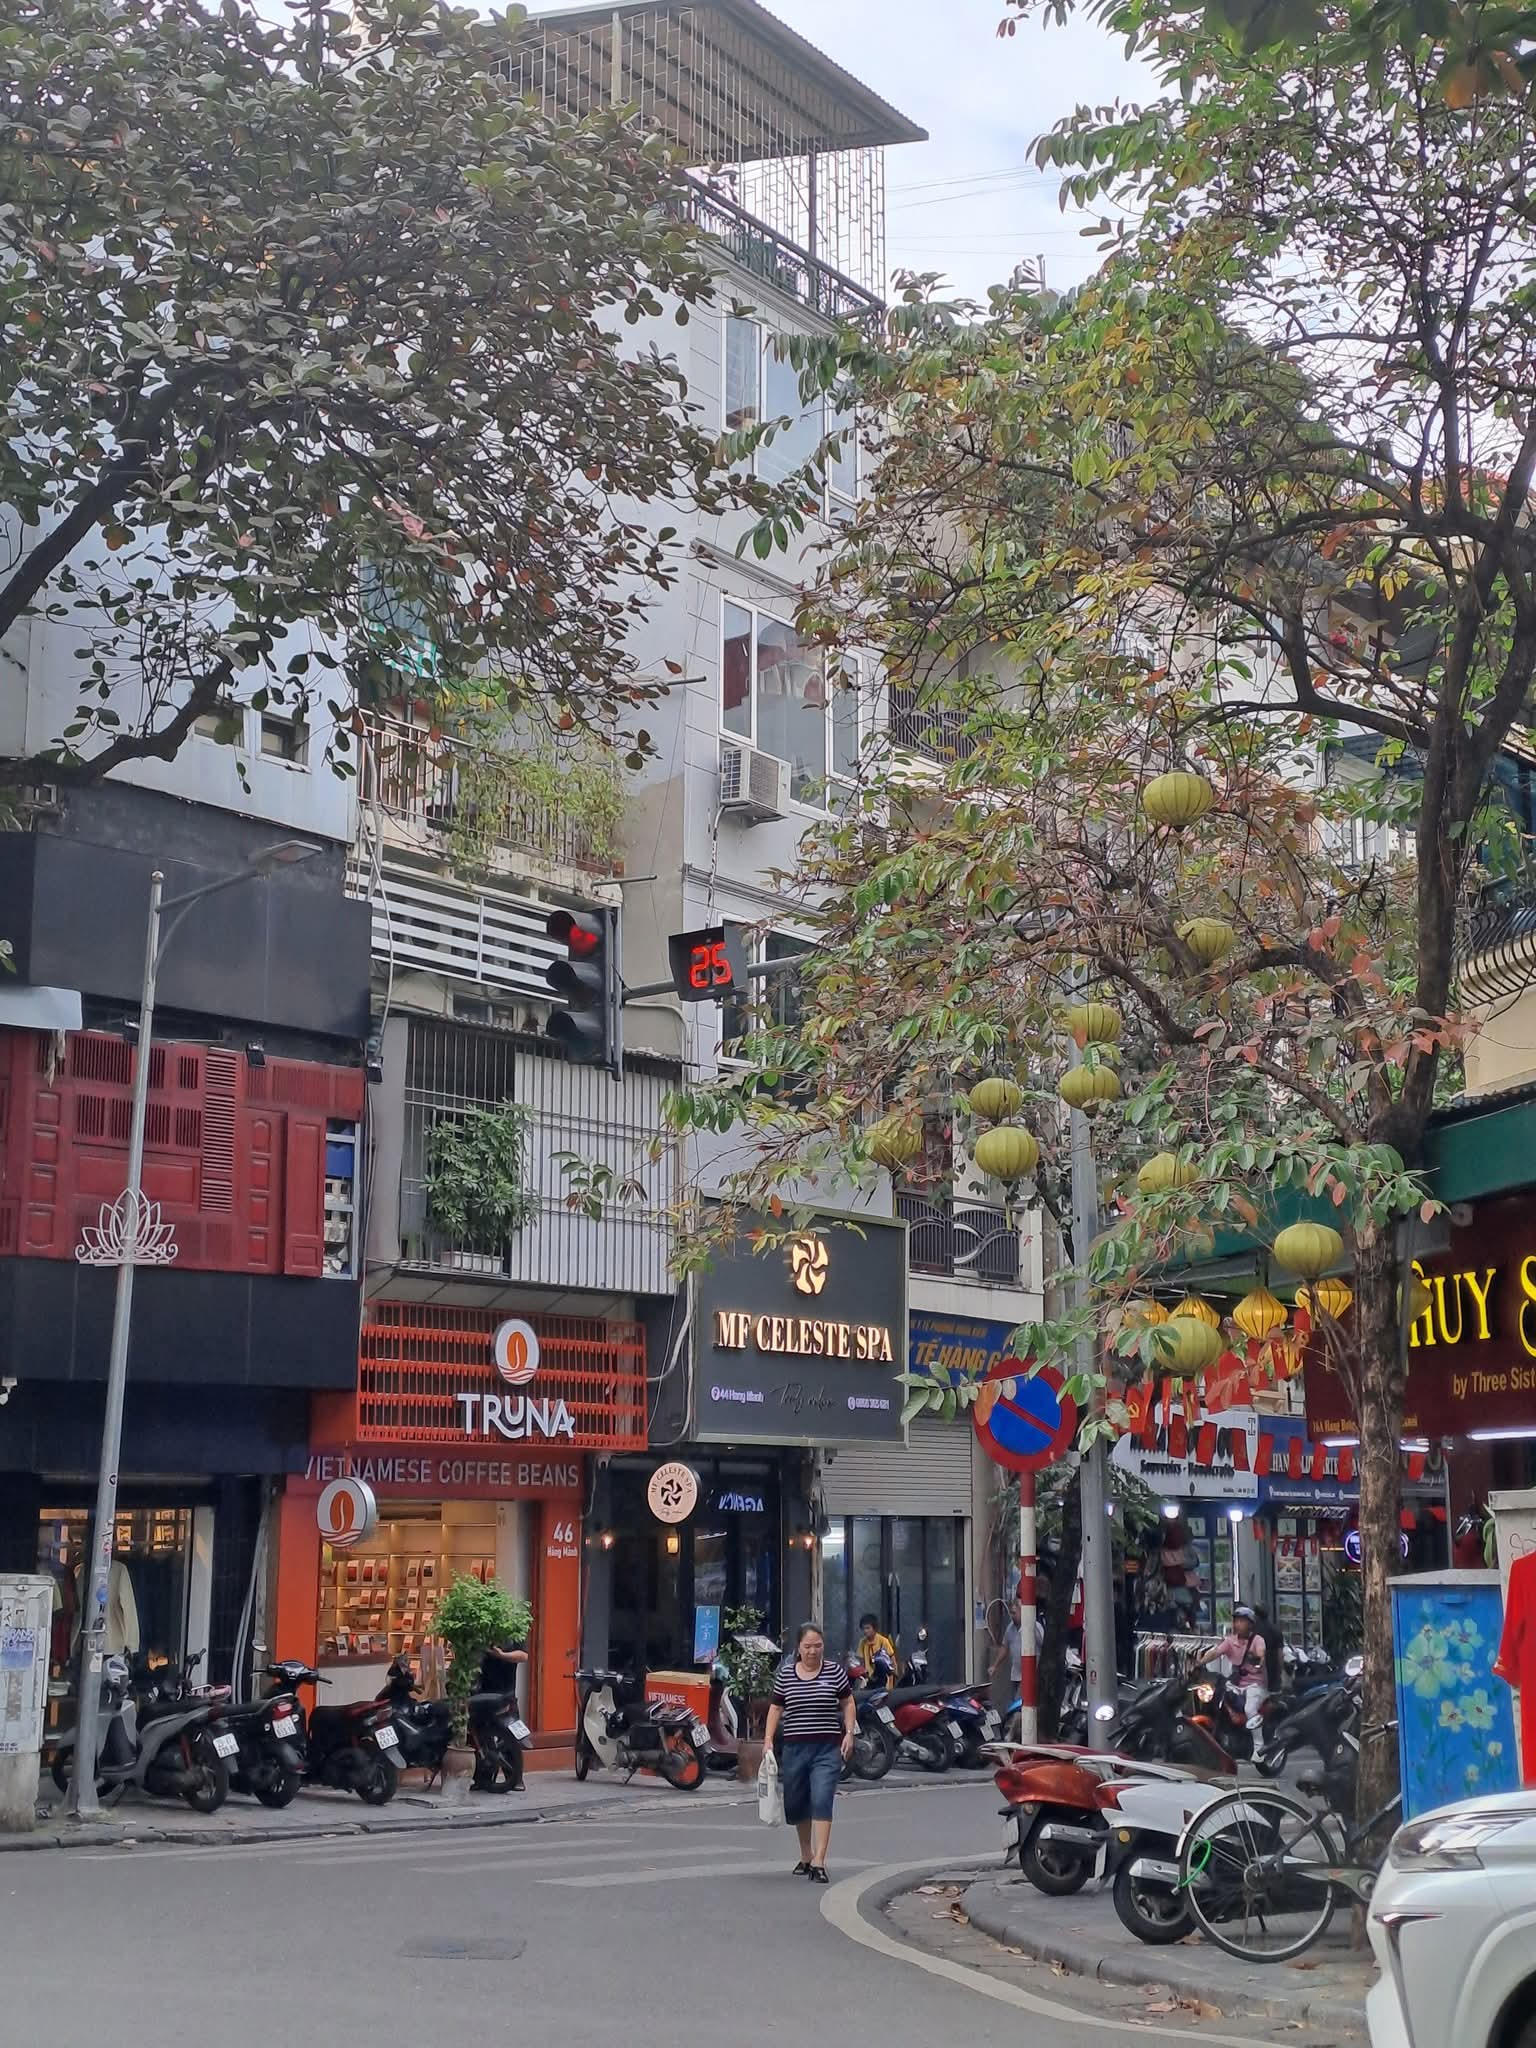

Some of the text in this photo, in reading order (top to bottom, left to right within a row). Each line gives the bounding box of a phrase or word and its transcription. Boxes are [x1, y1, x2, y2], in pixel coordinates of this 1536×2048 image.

[690, 942, 732, 988] 25
[717, 1311, 750, 1348] MF
[756, 1314, 852, 1358] CELESTE
[855, 1325, 894, 1362] SPA
[1453, 1367, 1536, 1400] by Three Sist
[456, 1392, 576, 1440] TRUNA
[438, 1459, 511, 1486] COFFEE
[518, 1463, 579, 1488] BEANS
[553, 1521, 574, 1543] 46
